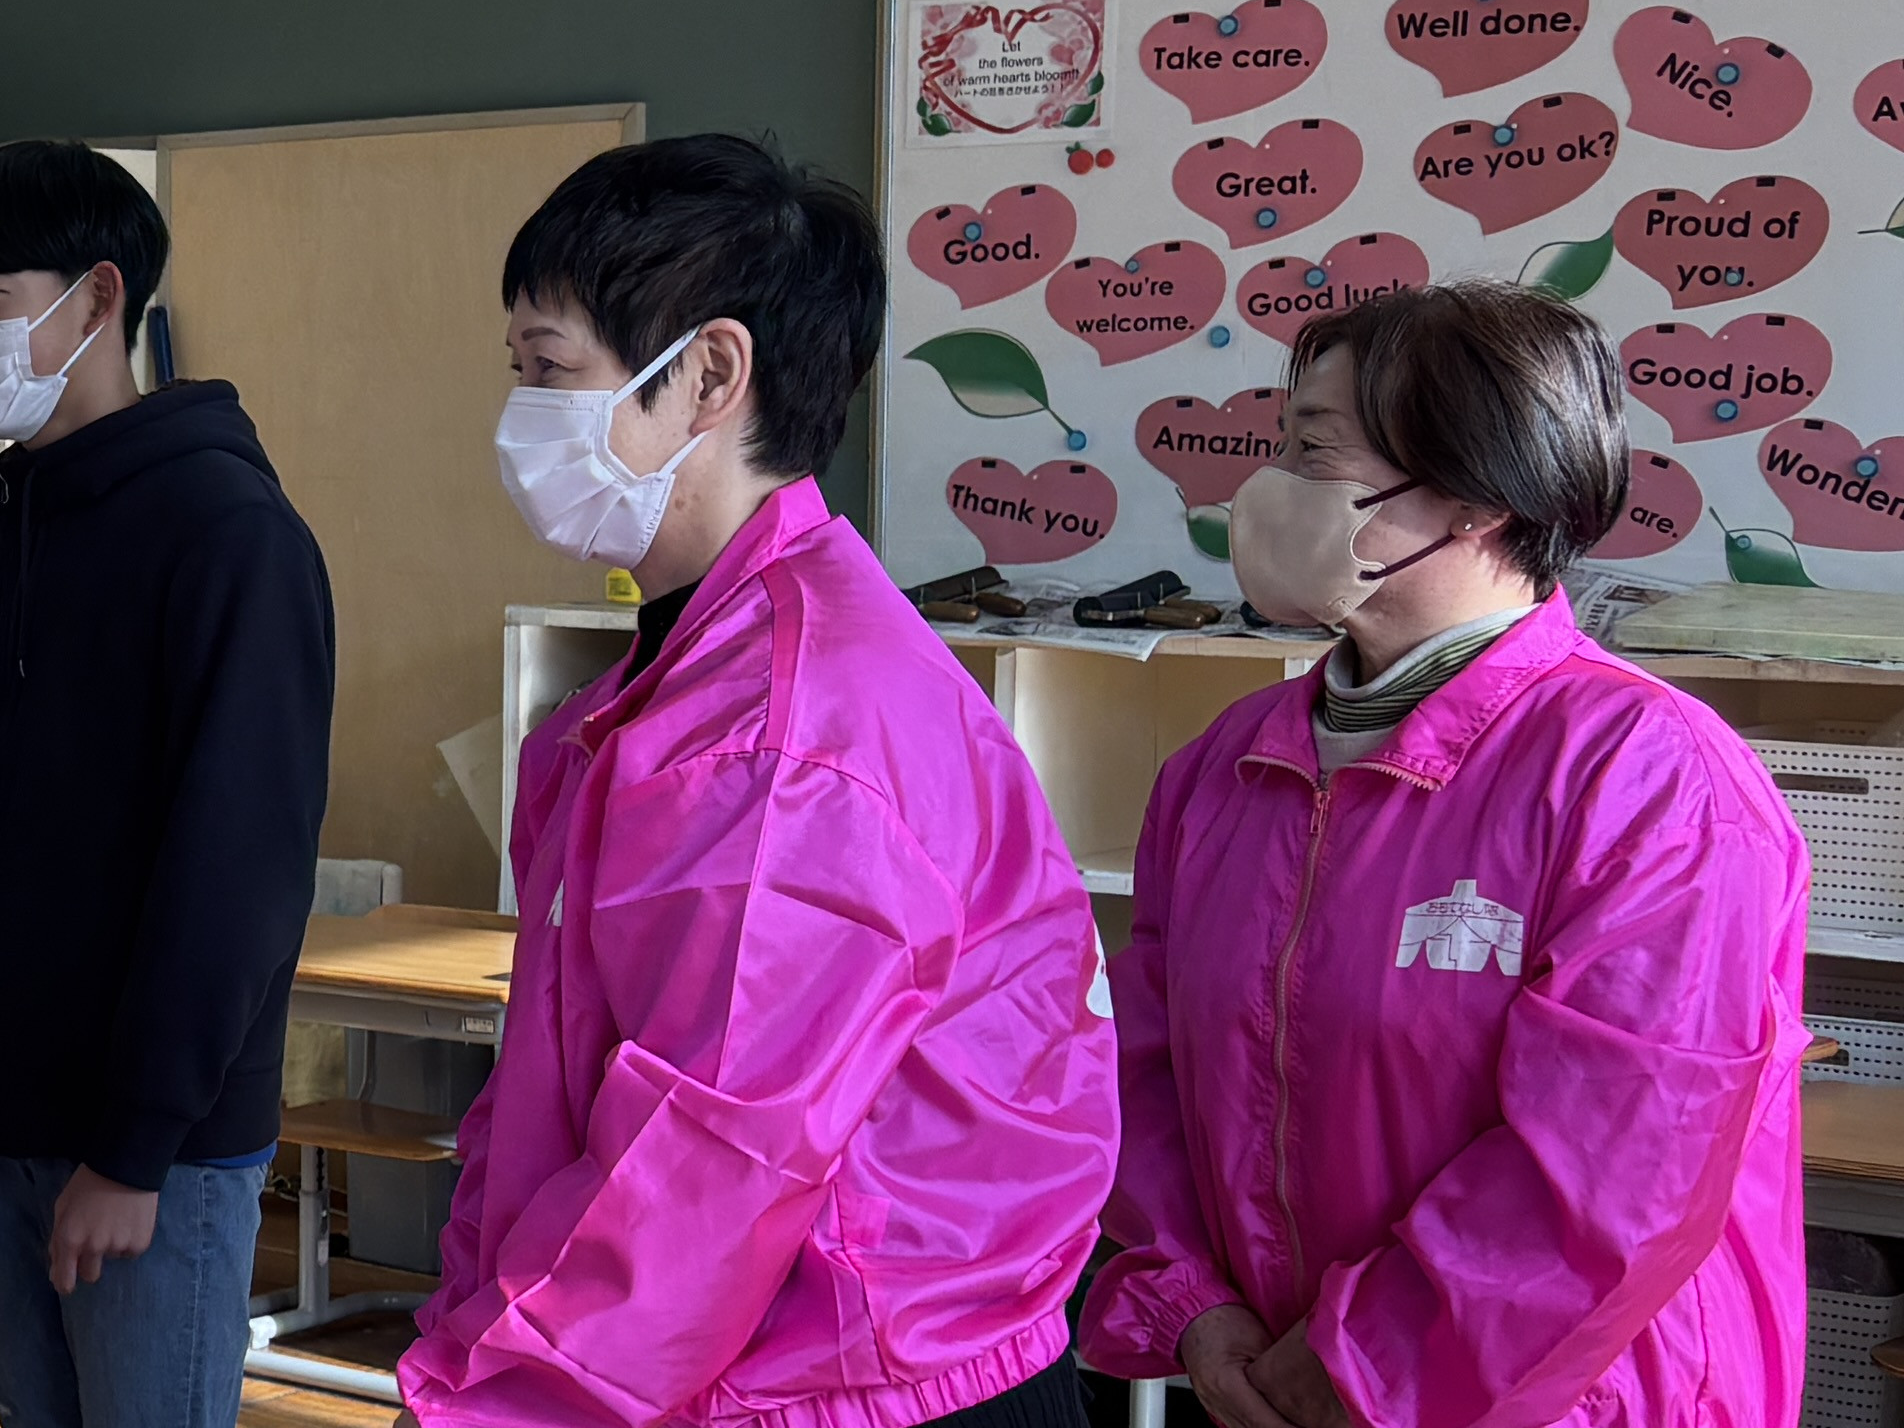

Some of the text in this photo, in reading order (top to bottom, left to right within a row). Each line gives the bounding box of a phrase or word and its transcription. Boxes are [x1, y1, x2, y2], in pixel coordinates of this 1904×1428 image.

[1397, 9, 1582, 39] Well done.
[1002, 42, 1021, 52] Let
[1153, 45, 1310, 72] Take care.
[978, 57, 1043, 69] the flowers
[943, 76, 954, 87] of
[958, 76, 990, 86] warm
[993, 72, 1031, 83] hearts
[1656, 53, 1734, 118] Nice.
[1419, 131, 1616, 182] Are you ok?
[1216, 169, 1317, 199] Great.
[1645, 209, 1801, 239] Proud of
[943, 233, 1041, 266] Good.
[1097, 276, 1174, 300] You're
[1677, 264, 1754, 292] you.
[1247, 283, 1335, 316] Good
[1075, 313, 1195, 336] welcome.
[1628, 358, 1814, 400] Good job.
[951, 484, 1105, 540] Thank you.
[1630, 506, 1678, 539] are.
